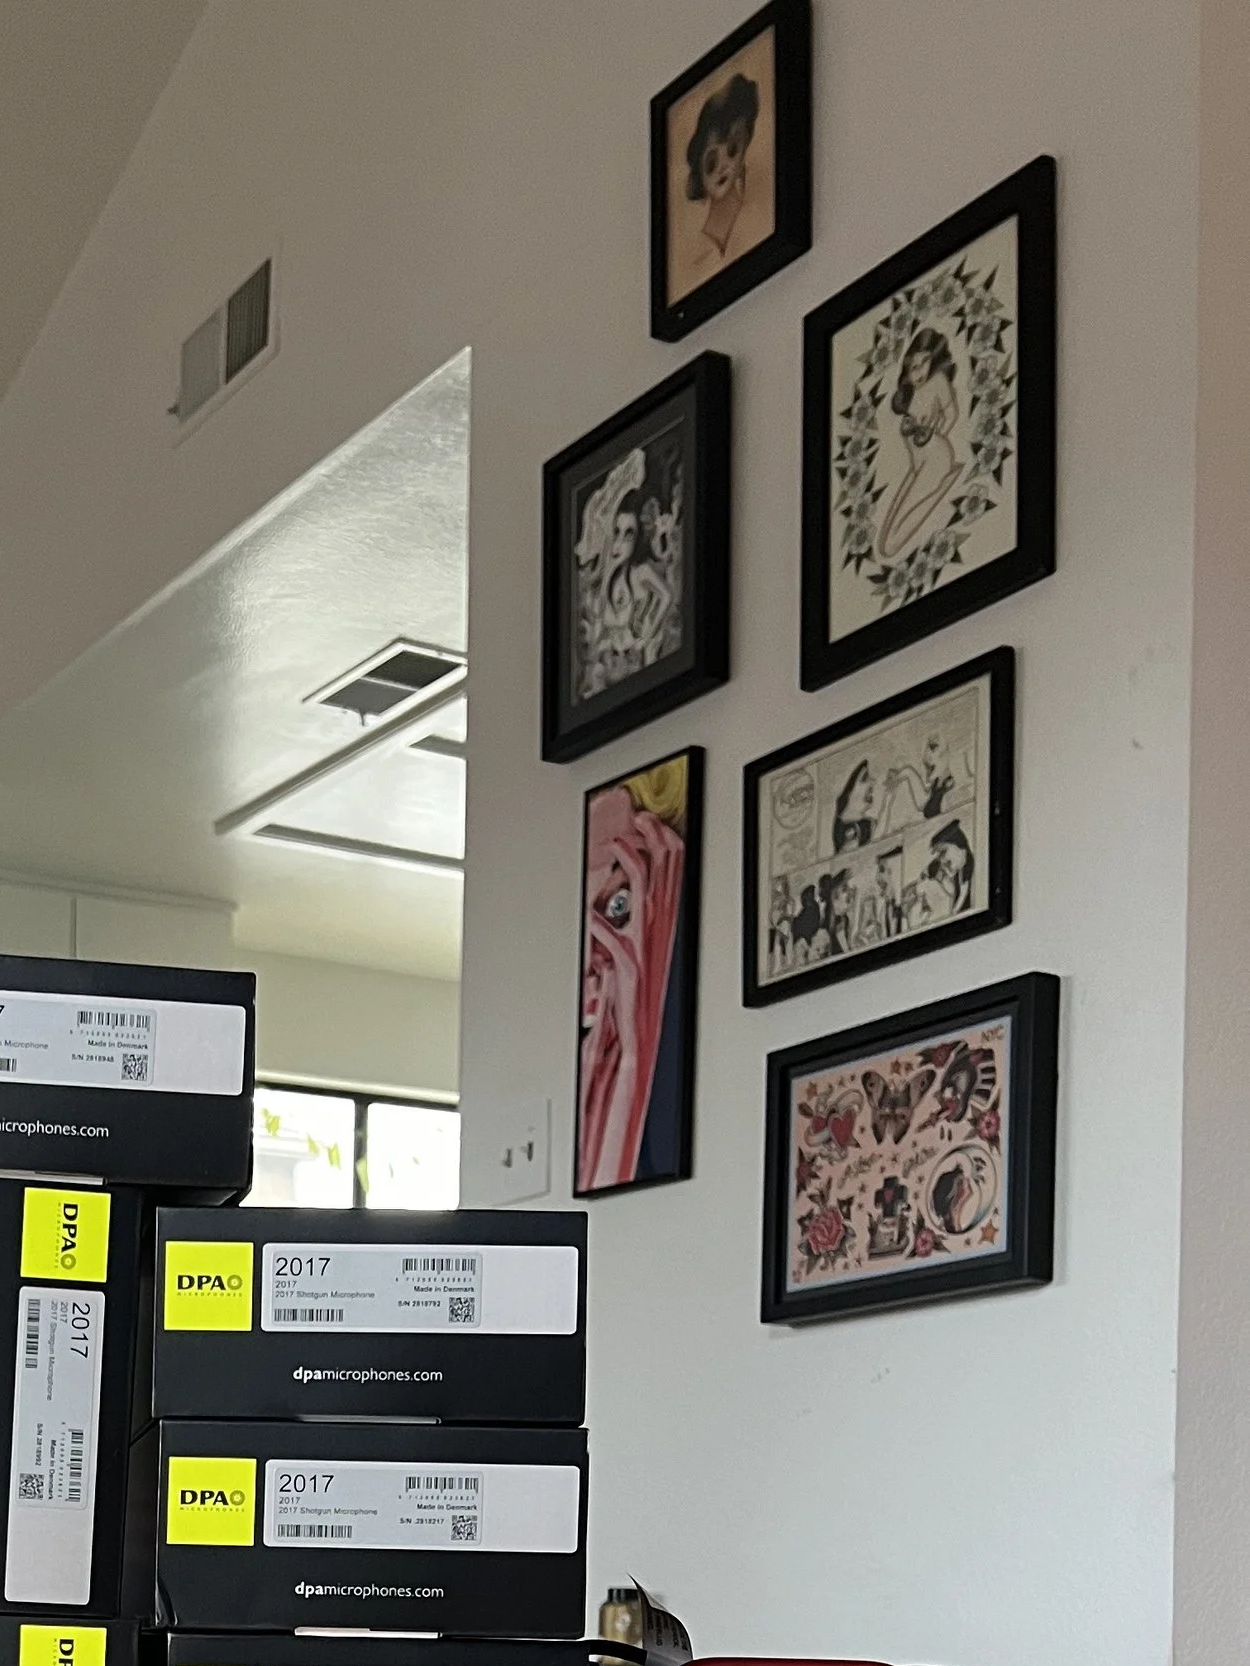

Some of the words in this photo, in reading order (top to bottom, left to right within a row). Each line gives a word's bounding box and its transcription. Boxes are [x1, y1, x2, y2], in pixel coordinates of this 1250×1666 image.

[4, 1039, 49, 1050] Microphone
[62, 1204, 77, 1252] DPA
[276, 1257, 330, 1276] 2017
[178, 1276, 225, 1290] DPA
[275, 1280, 297, 1288] 2017
[60, 1301, 68, 1323] 2017
[70, 1303, 90, 1358] 2017
[293, 1367, 442, 1383] dpamicrophones.com
[280, 1474, 334, 1492] 2017
[181, 1490, 228, 1505] DPA
[279, 1497, 300, 1505] 2017
[295, 1582, 443, 1599] dpamicrophones.com
